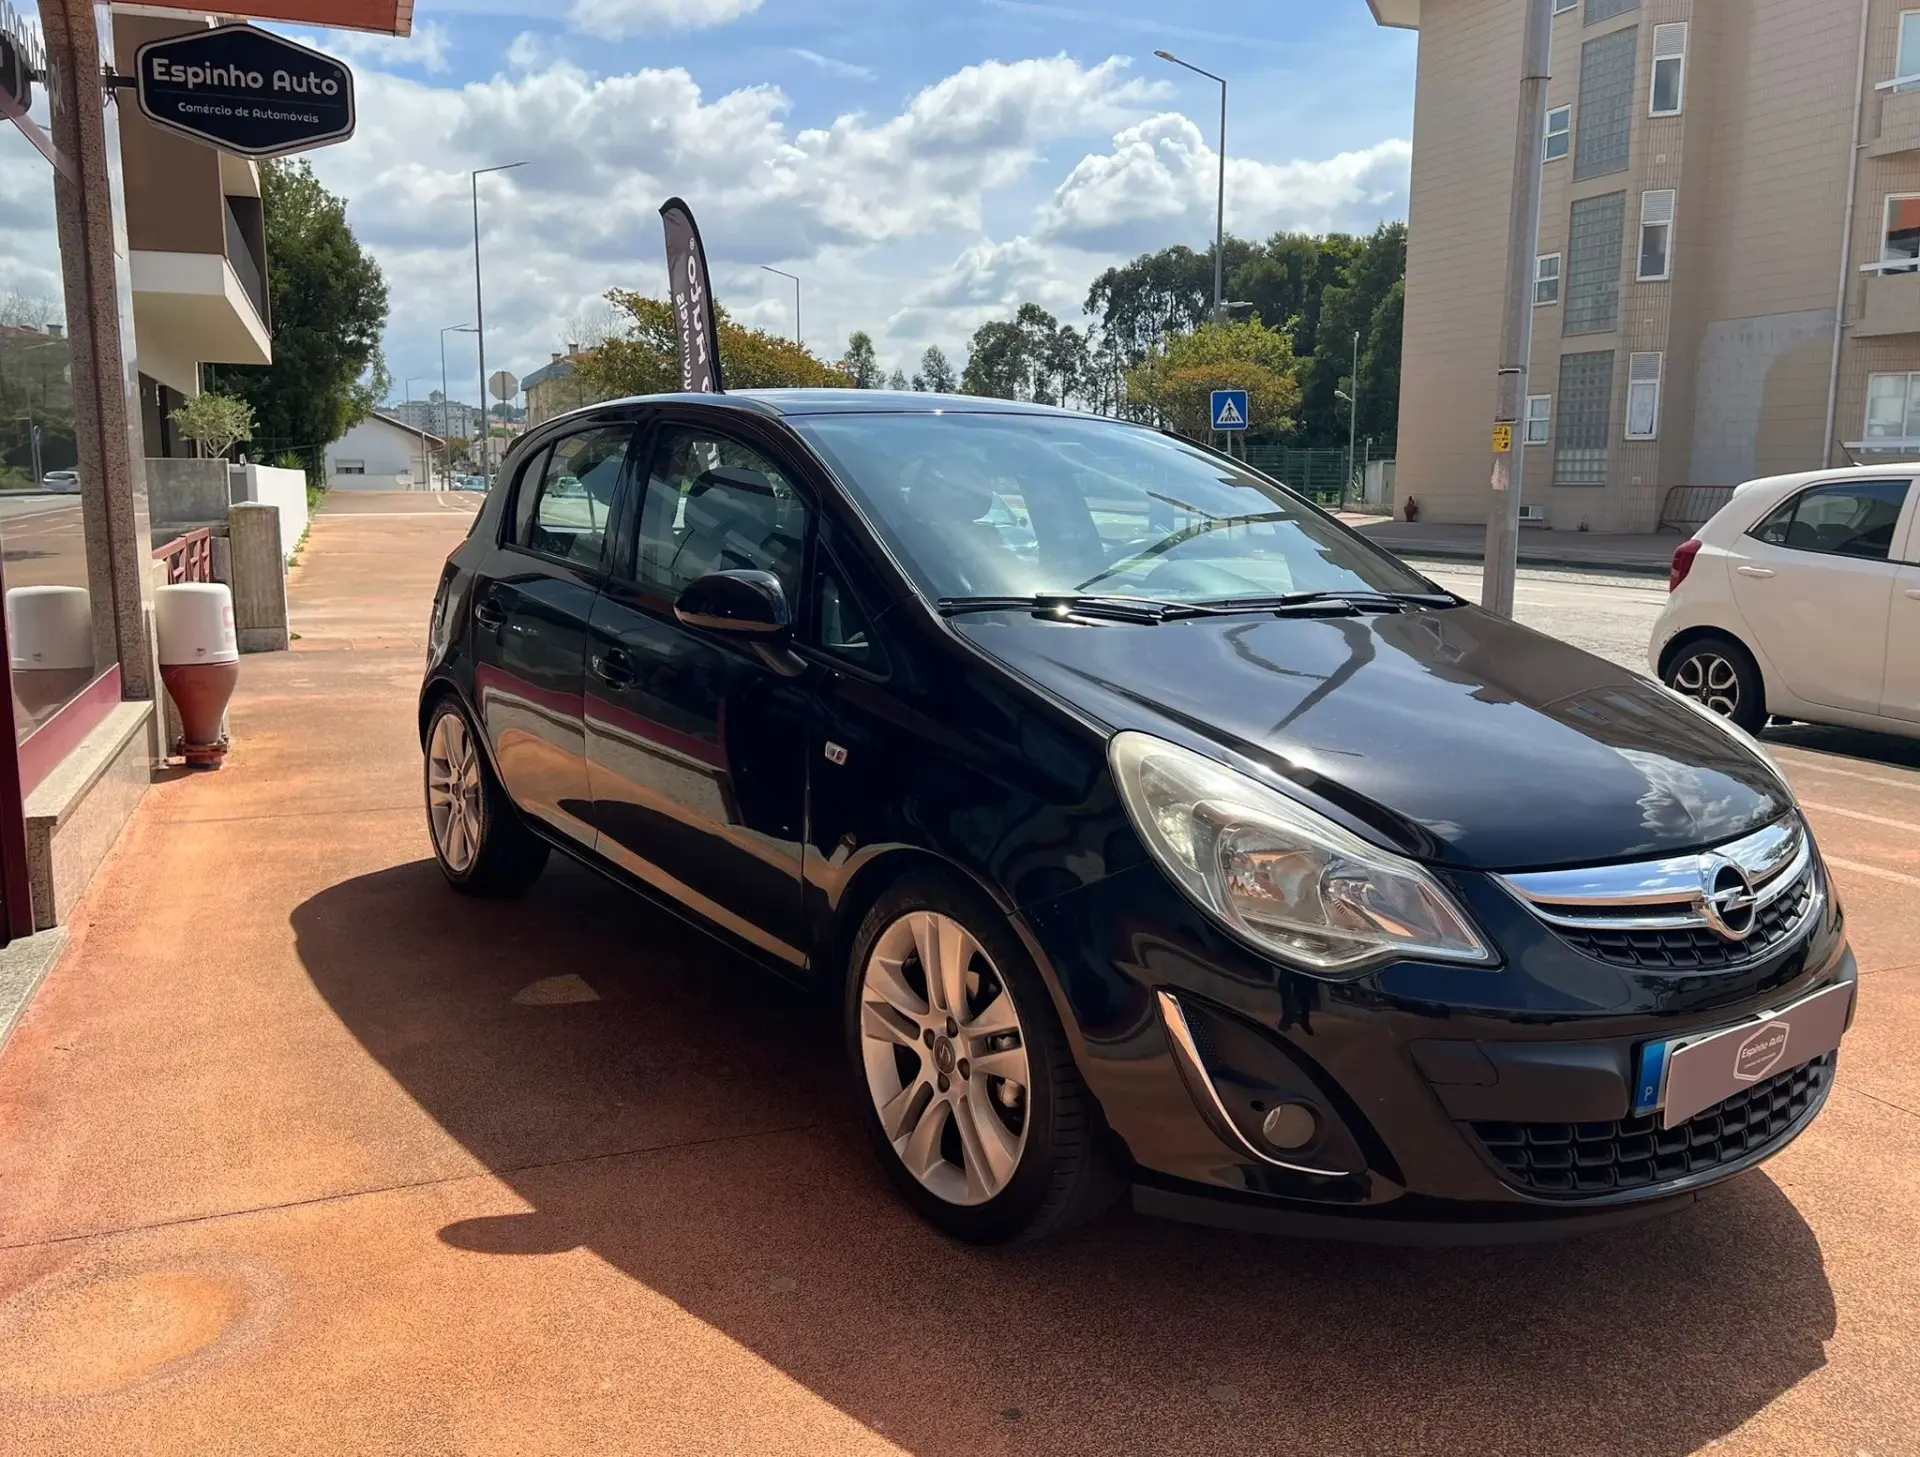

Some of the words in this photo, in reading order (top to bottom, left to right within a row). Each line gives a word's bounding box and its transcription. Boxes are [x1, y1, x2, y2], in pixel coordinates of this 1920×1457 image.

[152, 57, 264, 89] Espinho
[272, 69, 339, 96] Auto
[178, 102, 232, 116] Comércio
[235, 106, 250, 117] de
[252, 108, 319, 124] Automóveis
[1644, 1085, 1654, 1102] P
